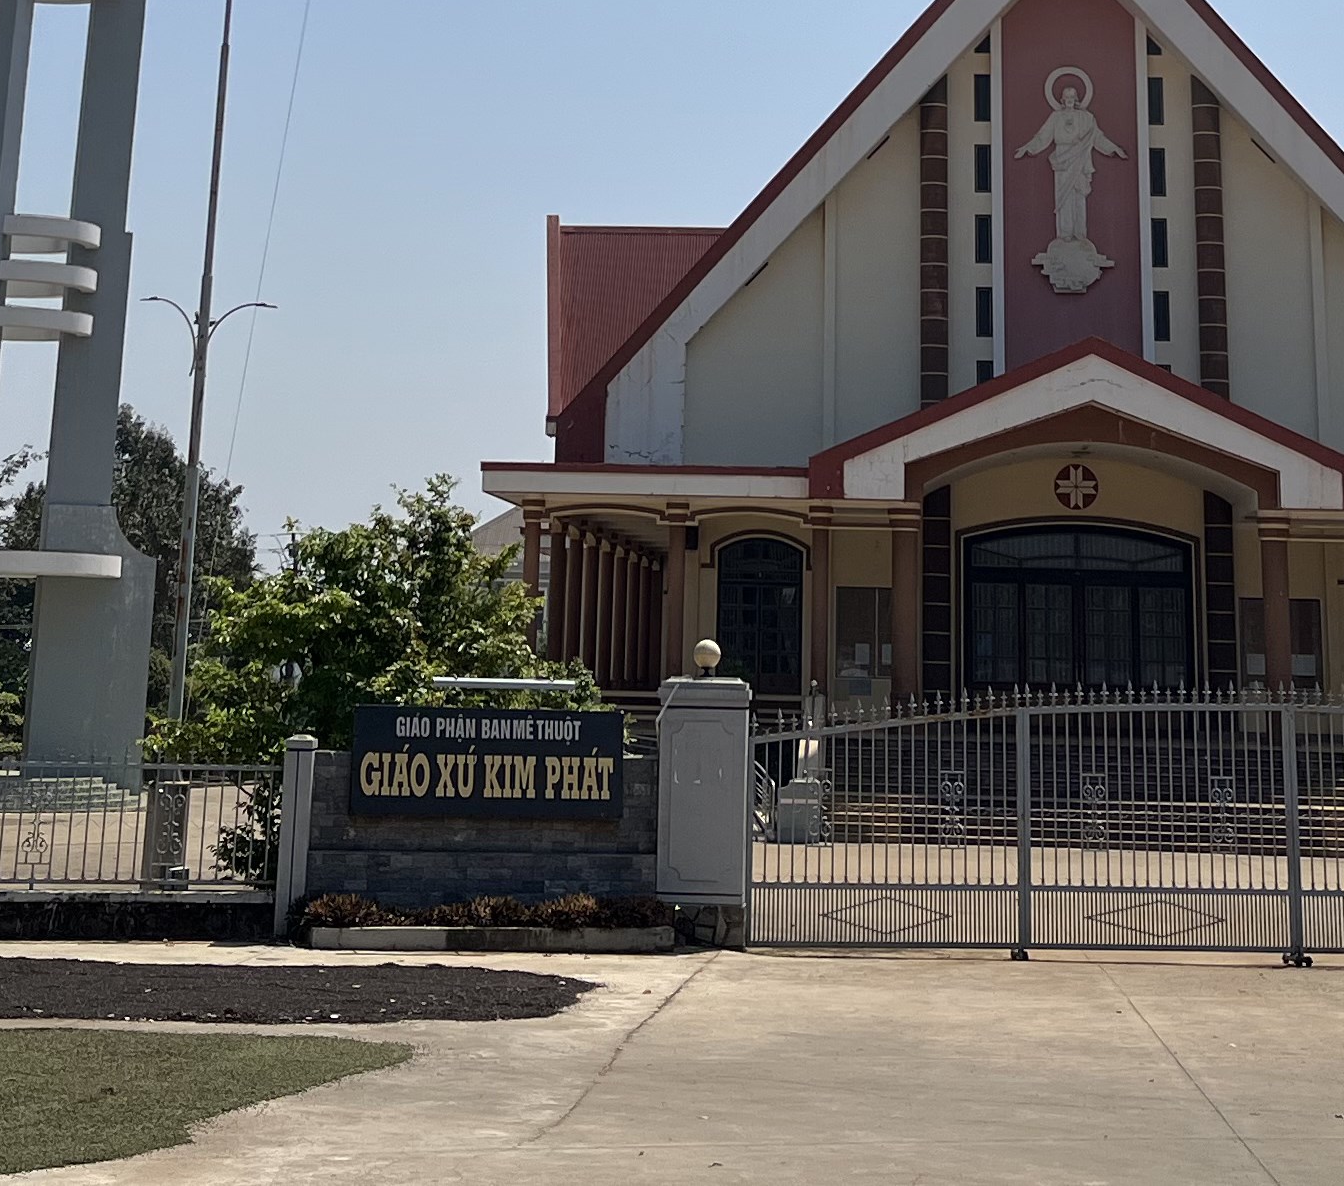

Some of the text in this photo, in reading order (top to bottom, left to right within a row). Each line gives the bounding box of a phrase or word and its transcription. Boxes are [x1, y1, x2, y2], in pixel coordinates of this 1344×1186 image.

[396, 713, 430, 737] GIÁO
[436, 714, 476, 742] PHẬN
[536, 716, 582, 745] THUỘT
[360, 744, 614, 800] GIÁO XỨ KIM PHÁT
